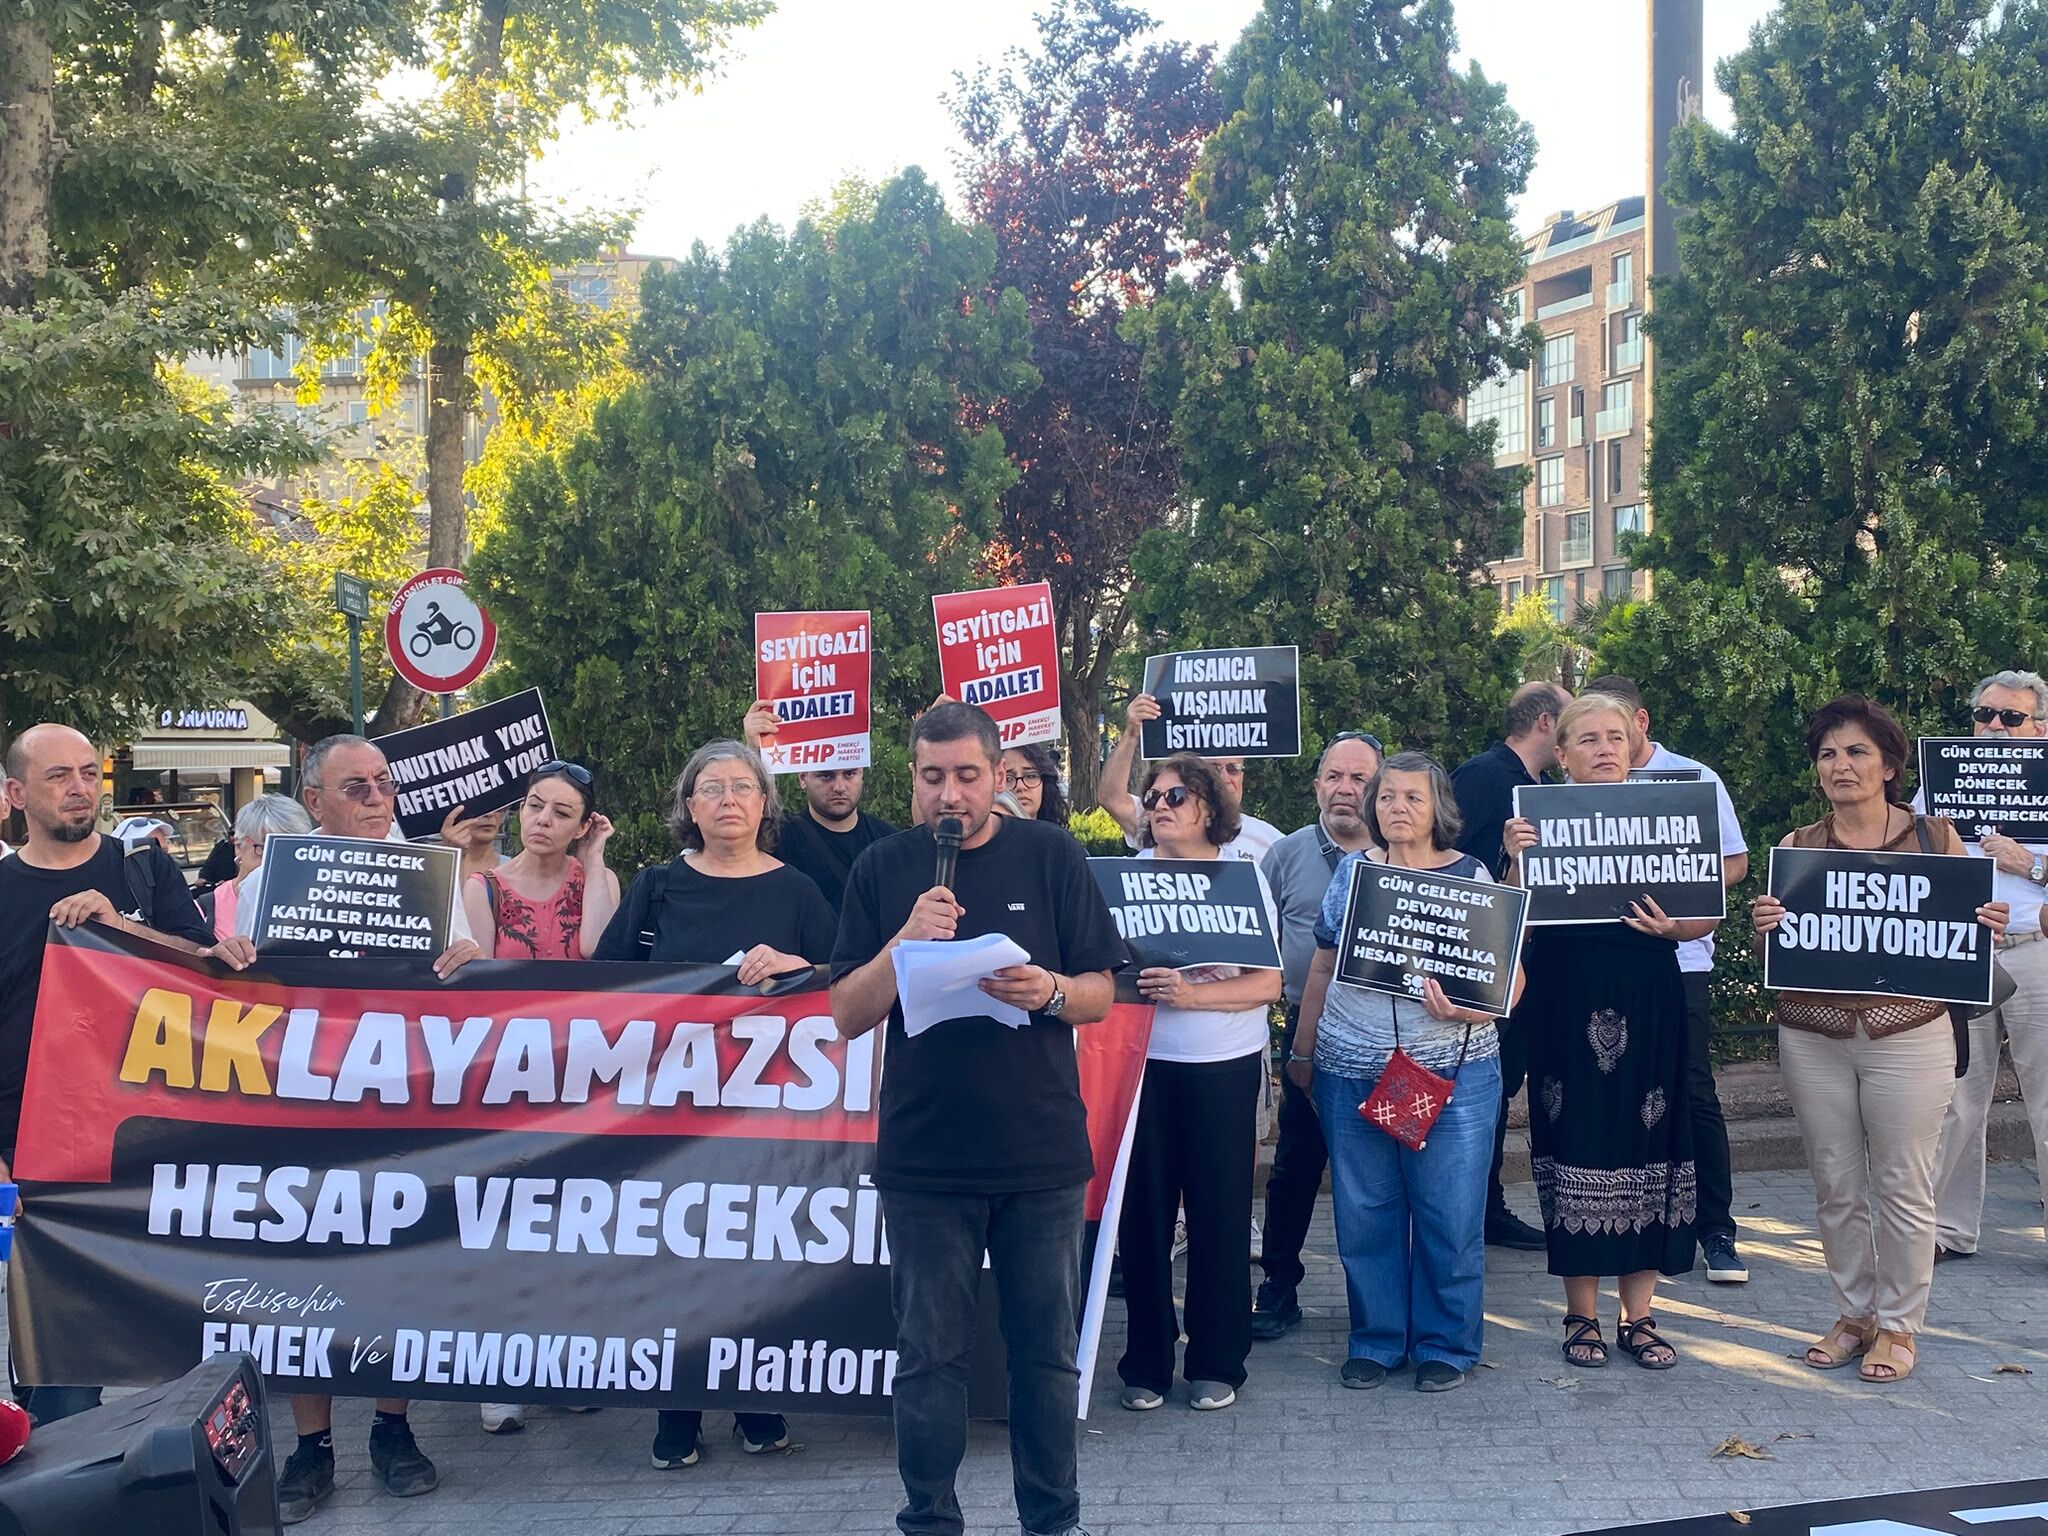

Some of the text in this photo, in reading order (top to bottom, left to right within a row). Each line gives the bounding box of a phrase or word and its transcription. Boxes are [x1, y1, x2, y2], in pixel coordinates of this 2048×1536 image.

[389, 576, 443, 615] MOTOSİKLET
[942, 596, 1050, 646] SEYİTGAZİ
[761, 625, 866, 663] SEYİTGAZİ
[976, 638, 1022, 674] İÇİN
[792, 660, 836, 694] İÇİN
[1174, 656, 1256, 683] İNSANCA
[965, 669, 1040, 705] ADALET
[777, 693, 852, 721] ADALET
[1171, 689, 1267, 718] YAŞAMAK
[495, 714, 544, 751] YOK!
[1000, 722, 1025, 742] HP
[1165, 719, 1268, 749] İSTİYORUZ!
[790, 744, 835, 764] EHP
[1940, 745, 2044, 759] GÜN GELECEK
[397, 743, 550, 816] AFFETMEK YOK!
[1954, 776, 2027, 790] DÖNECEK
[1958, 763, 2022, 774] DEVRAN
[1934, 790, 1996, 805] KATİLLER
[1934, 808, 1975, 820] HESAP
[1540, 812, 1701, 848] KATLİAMLARA
[294, 845, 425, 871] GÜN GELECEK
[1237, 849, 1254, 860] Lee
[317, 868, 397, 888] DEVRAN
[1527, 847, 1719, 895] ALIŞMAYACAĞIZ!
[307, 885, 402, 908] DÖNECEK
[1120, 872, 1211, 901] HESAP
[1378, 875, 1495, 908] GÜN GELECEK
[1825, 870, 1931, 913] HESAP
[271, 903, 432, 931] KATİLLER HALKA
[1007, 903, 1025, 911] VANS
[1108, 904, 1263, 939] ORUYORUZ!
[1396, 897, 1467, 922] DEVRAN
[267, 925, 432, 950] HESAP VERECEK!
[1387, 914, 1471, 941] DÖNECEK
[1778, 911, 1978, 962] SORUYORUZ!
[1357, 927, 1496, 966] KATİLLER HALKA
[1353, 945, 1495, 984] HESAP VERECEK!
[1401, 973, 1425, 989] SO
[1408, 987, 1425, 997] PAR
[119, 988, 889, 1113] AKLAYAMAZSI
[148, 1163, 891, 1265] HESAP VERECEKSİ
[202, 1321, 336, 1378] EMEK
[350, 1335, 388, 1374] Ve
[392, 1327, 677, 1392] DEMOKRASİ
